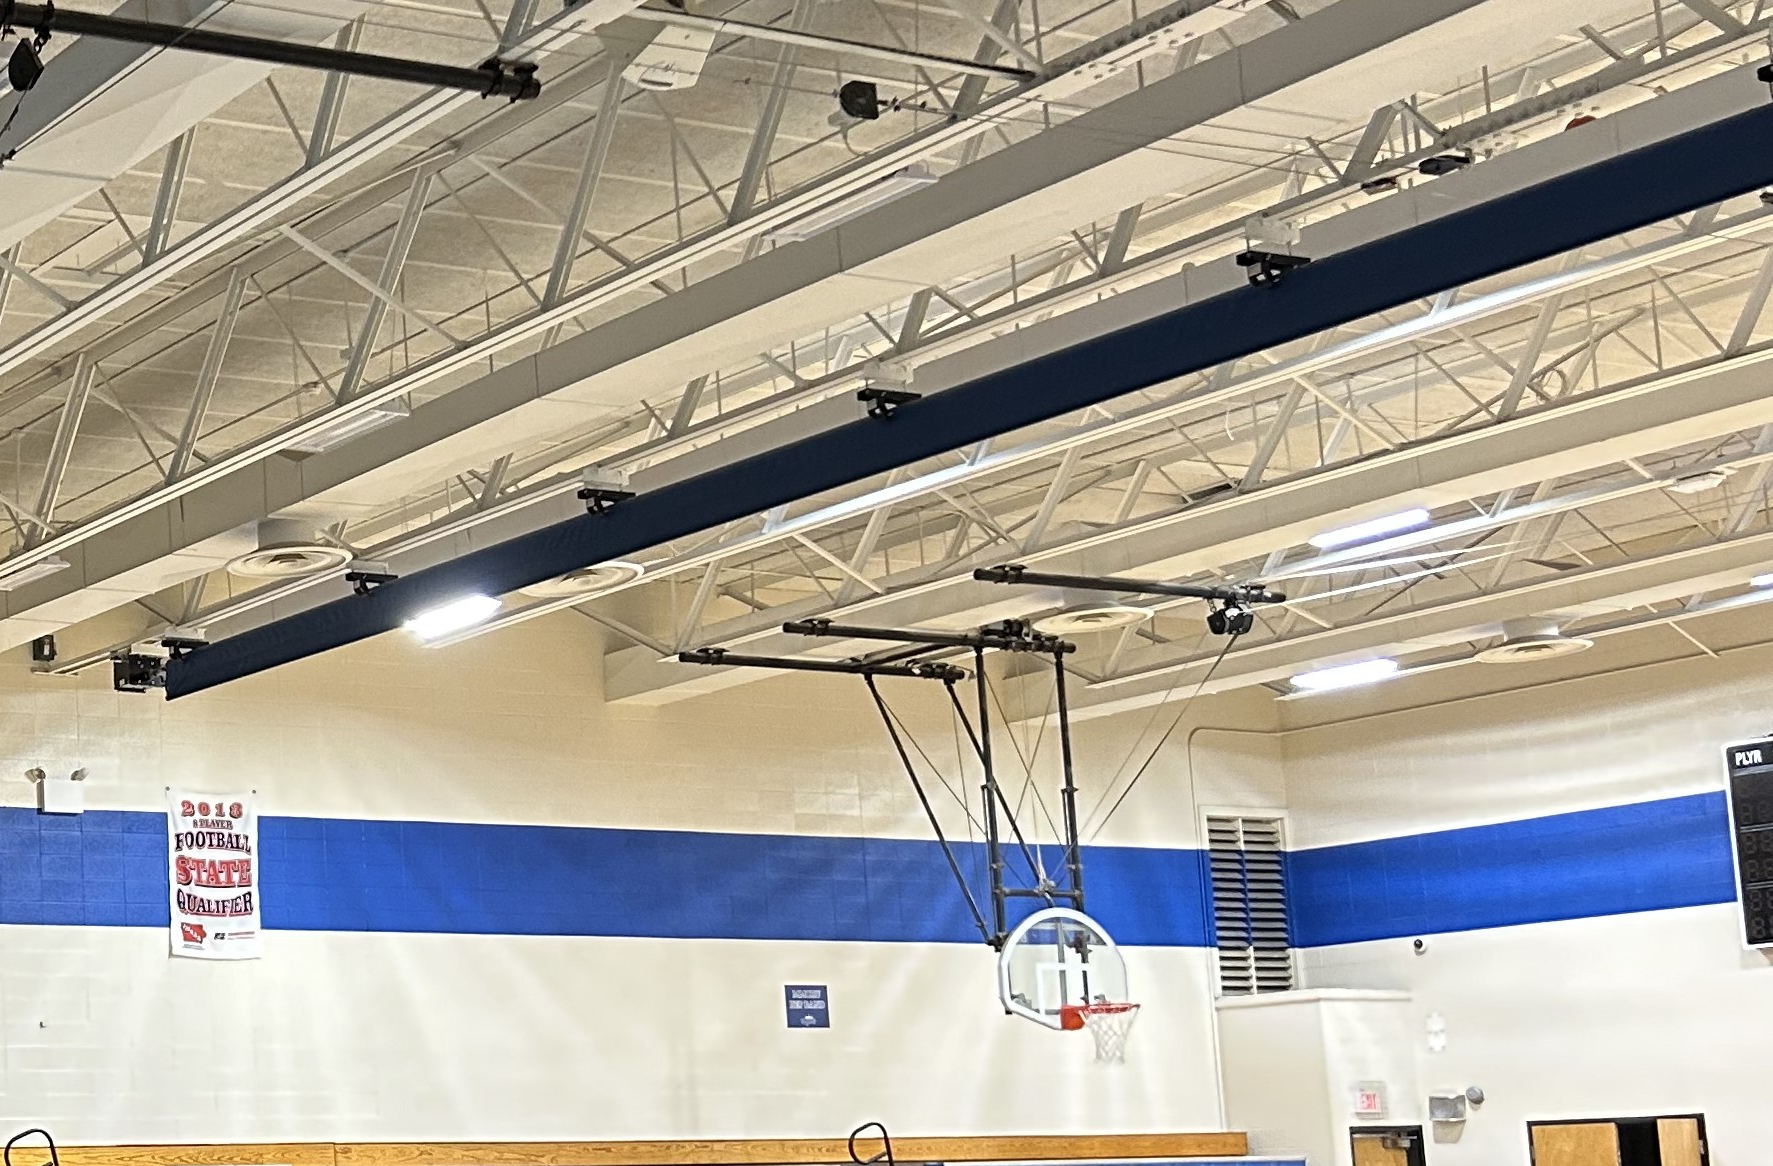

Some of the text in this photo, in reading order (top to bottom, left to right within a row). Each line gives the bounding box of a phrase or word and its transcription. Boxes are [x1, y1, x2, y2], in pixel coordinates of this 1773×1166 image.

[1735, 749, 1763, 766] PLYR
[174, 831, 252, 856] FOOTBALL
[175, 854, 253, 889] STATE
[176, 888, 254, 917] QUALIFIER
